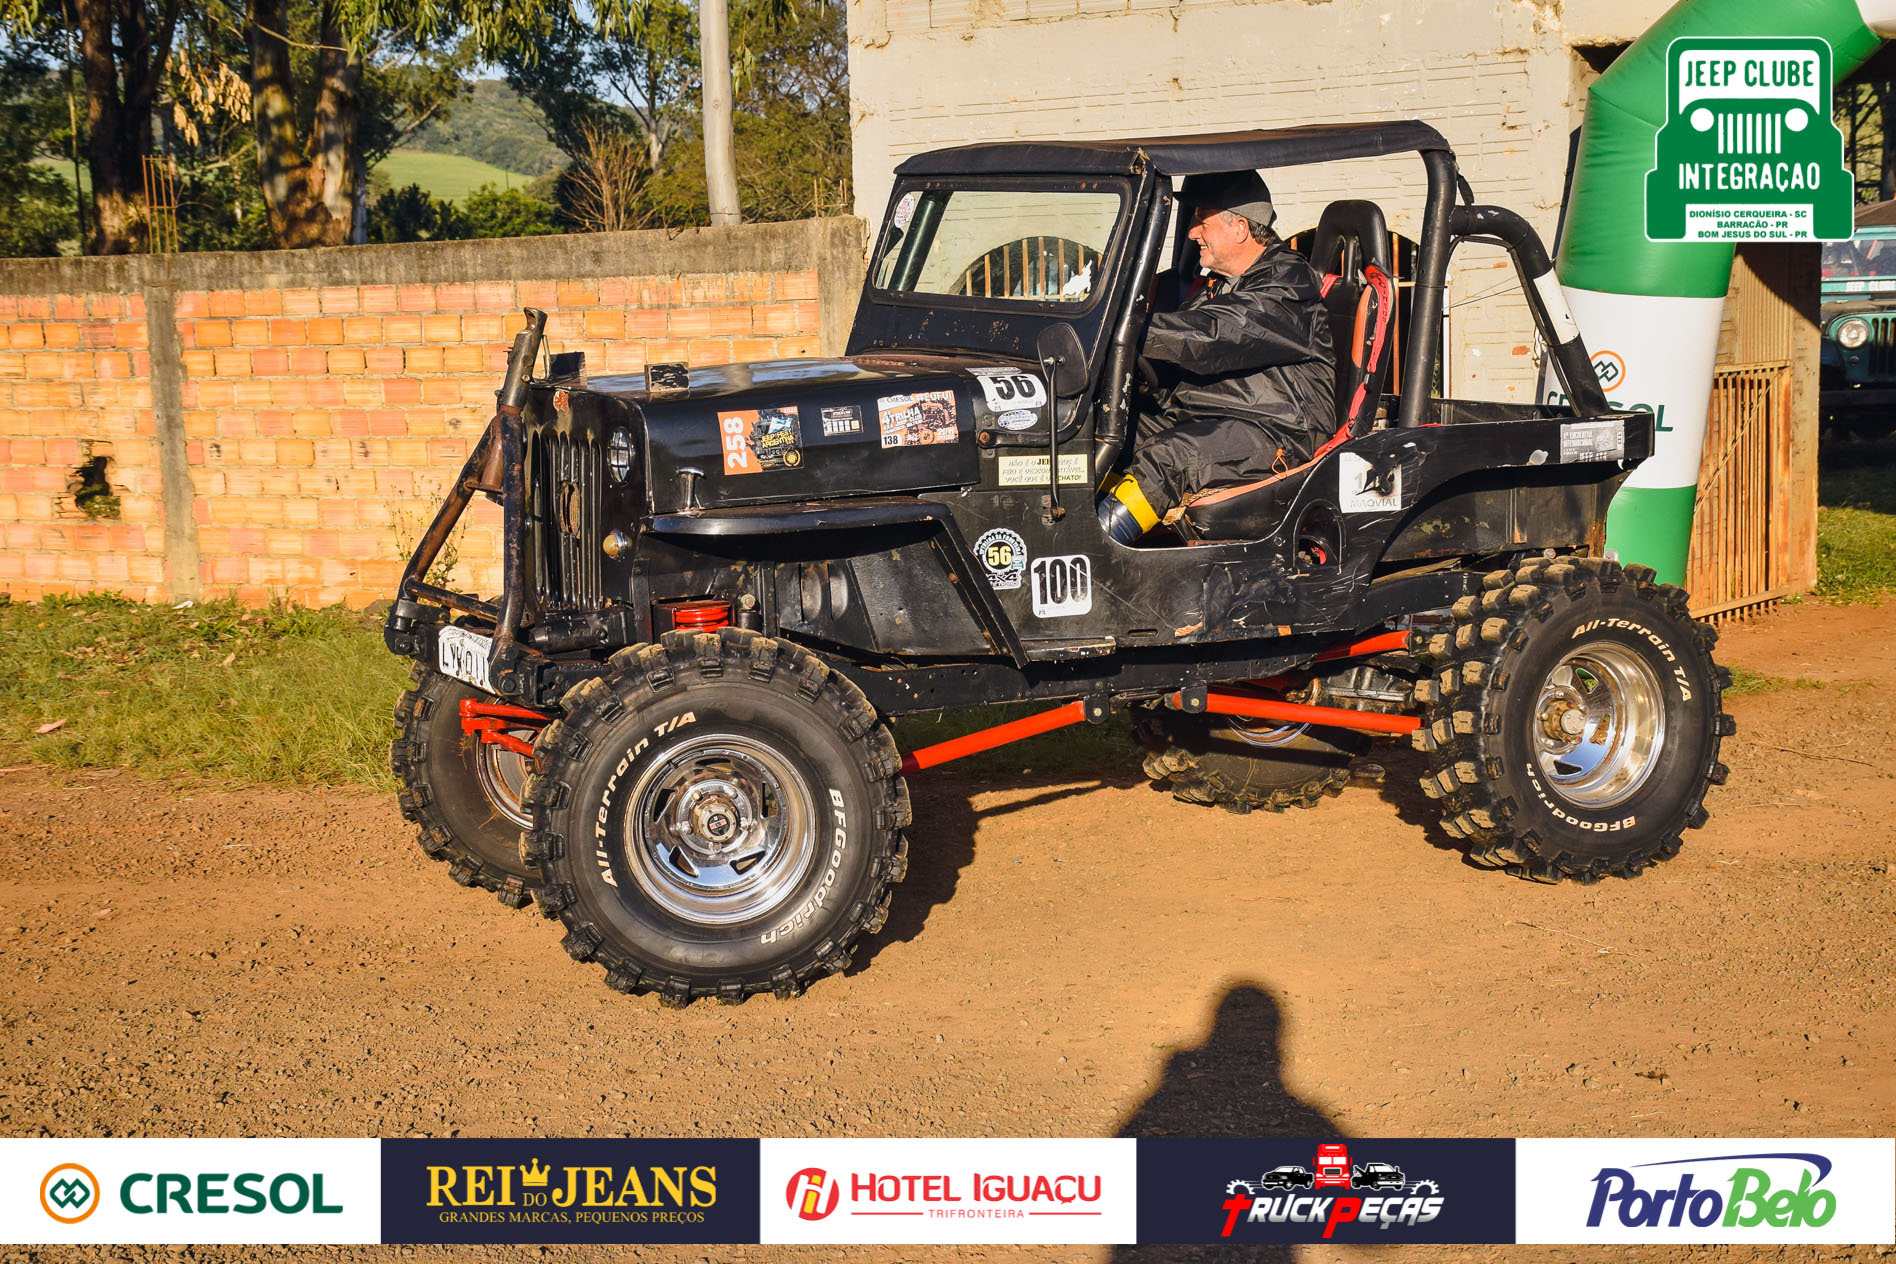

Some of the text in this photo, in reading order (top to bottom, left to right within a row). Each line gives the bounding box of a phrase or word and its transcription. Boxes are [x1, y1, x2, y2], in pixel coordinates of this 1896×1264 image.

[989, 375, 1036, 400] 56
[889, 406, 921, 422] TRILHA
[724, 416, 748, 468] 258
[883, 435, 898, 445] 138
[987, 545, 1012, 567] 56
[1034, 556, 1089, 605] 100
[1571, 618, 1693, 702] All-Terrain T/A
[595, 711, 697, 888] All-Terrain T/A
[1526, 763, 1636, 832] BFGoodrich
[760, 788, 847, 945] BFGoodrich
